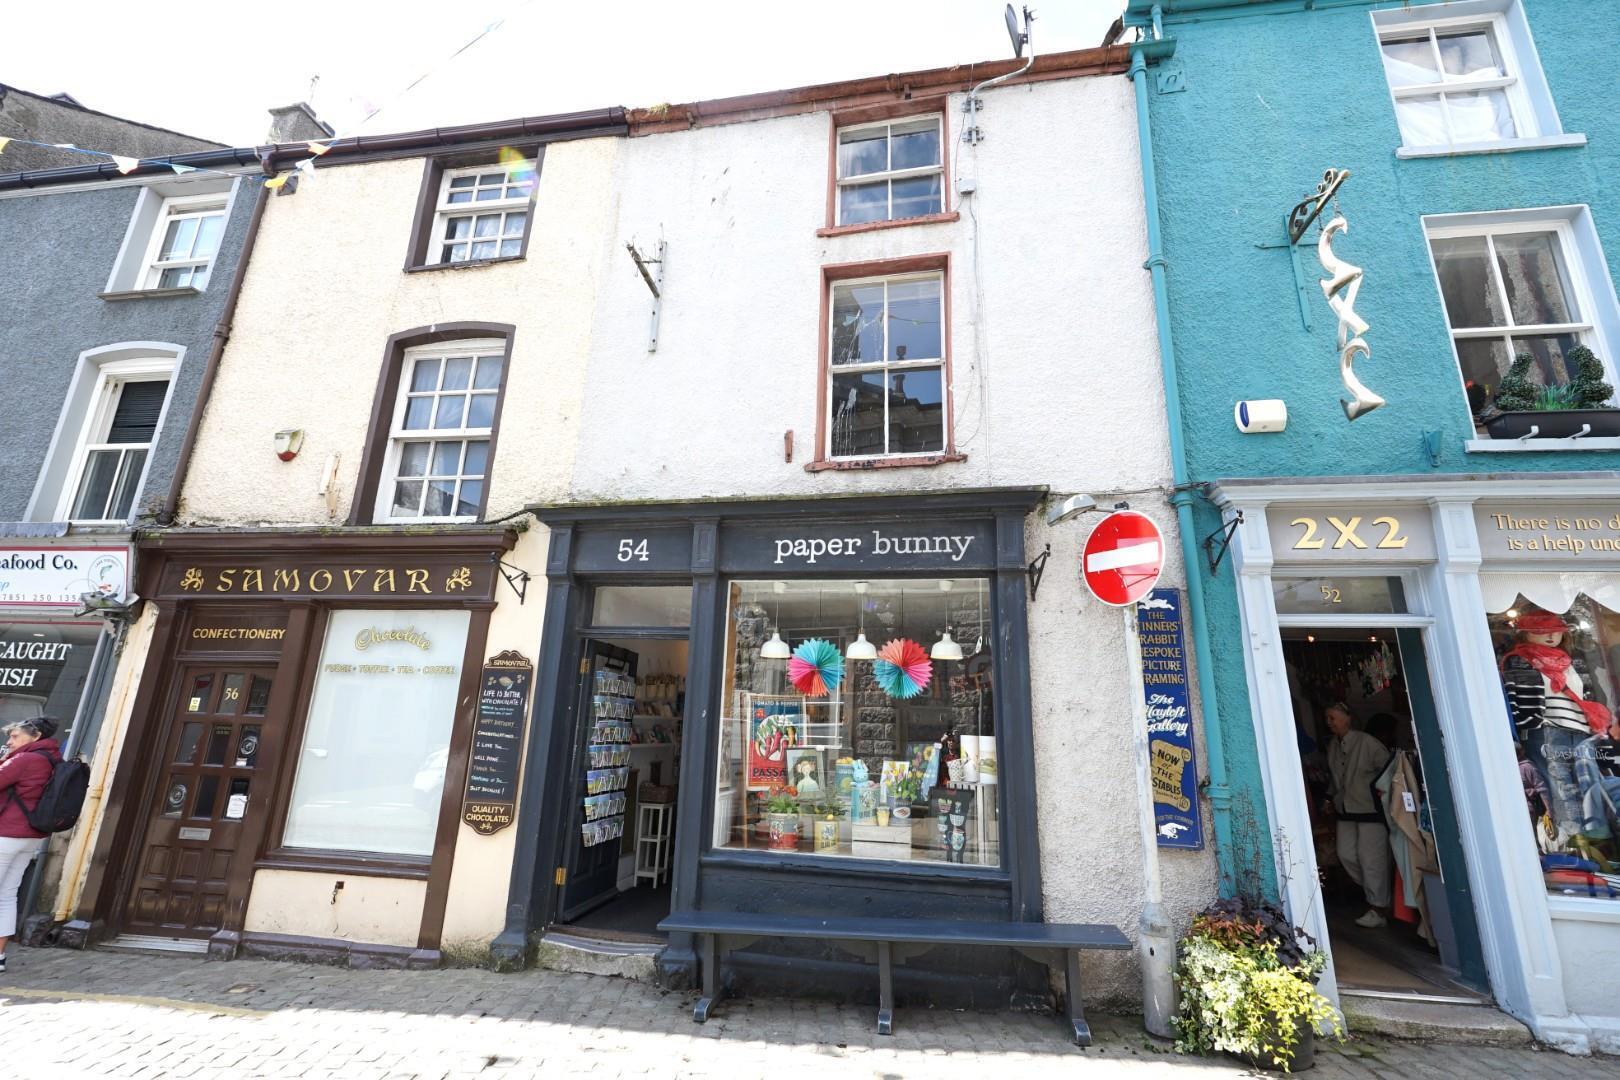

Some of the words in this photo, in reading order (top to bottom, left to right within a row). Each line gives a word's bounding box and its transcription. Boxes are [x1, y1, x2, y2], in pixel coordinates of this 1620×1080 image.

[1490, 513, 1549, 530] There
[1555, 515, 1571, 530] is
[1576, 518, 1602, 530] no
[1289, 516, 1409, 549] 2X2
[616, 538, 650, 562] 54
[774, 537, 861, 564] paper
[872, 530, 975, 561] bunny
[1507, 535, 1523, 550] is
[1527, 539, 1538, 550] a
[1543, 534, 1585, 555] help
[0, 553, 45, 569] afood
[52, 554, 78, 570] Co.
[216, 567, 433, 594] SAMOVAR
[1320, 585, 1341, 603] 52
[1146, 611, 1165, 620] THE
[192, 628, 286, 639] CONFECTIONERY
[1136, 621, 1180, 632] INNERS'
[1139, 633, 1178, 645] RABBIT
[1141, 647, 1182, 658] ESPOKE
[1142, 660, 1182, 672] PICTURE
[225, 687, 239, 701] 56
[1147, 693, 1175, 705] The
[1157, 748, 1180, 766] NOW
[1156, 766, 1175, 780] THE
[1152, 776, 1181, 796] STABLES
[471, 805, 505, 814] QUALITY
[465, 813, 509, 823] CHOCOLATES
